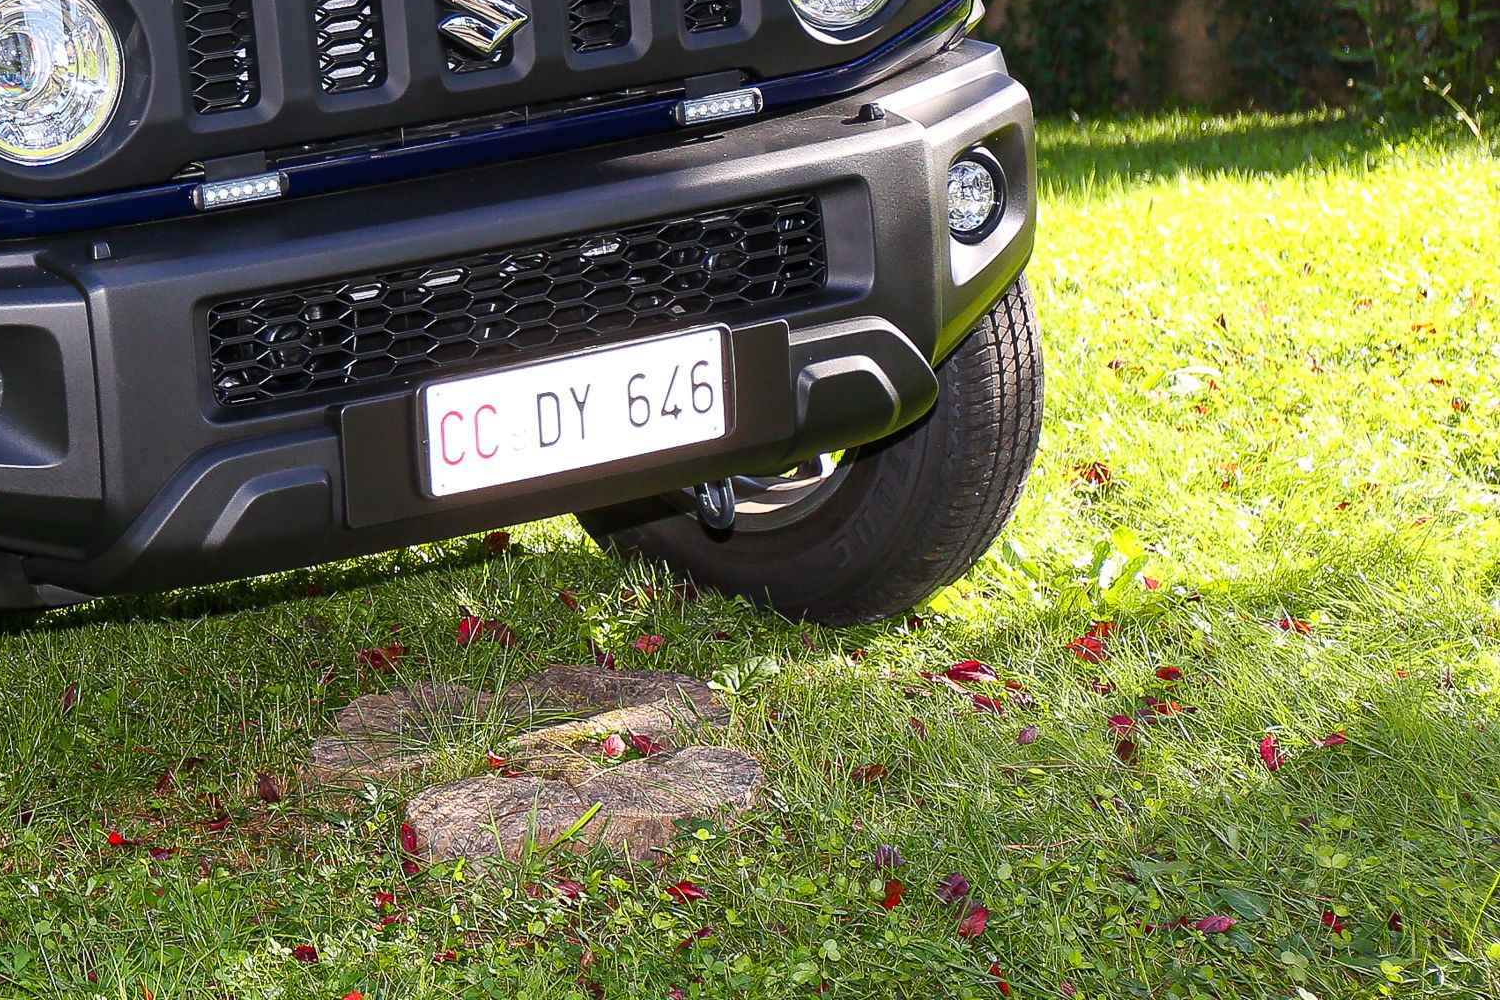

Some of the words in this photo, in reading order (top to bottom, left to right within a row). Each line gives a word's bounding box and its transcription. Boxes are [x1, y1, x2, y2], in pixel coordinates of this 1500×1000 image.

[440, 403, 500, 466] CC
[535, 383, 592, 449] DY
[627, 359, 714, 428] 646
